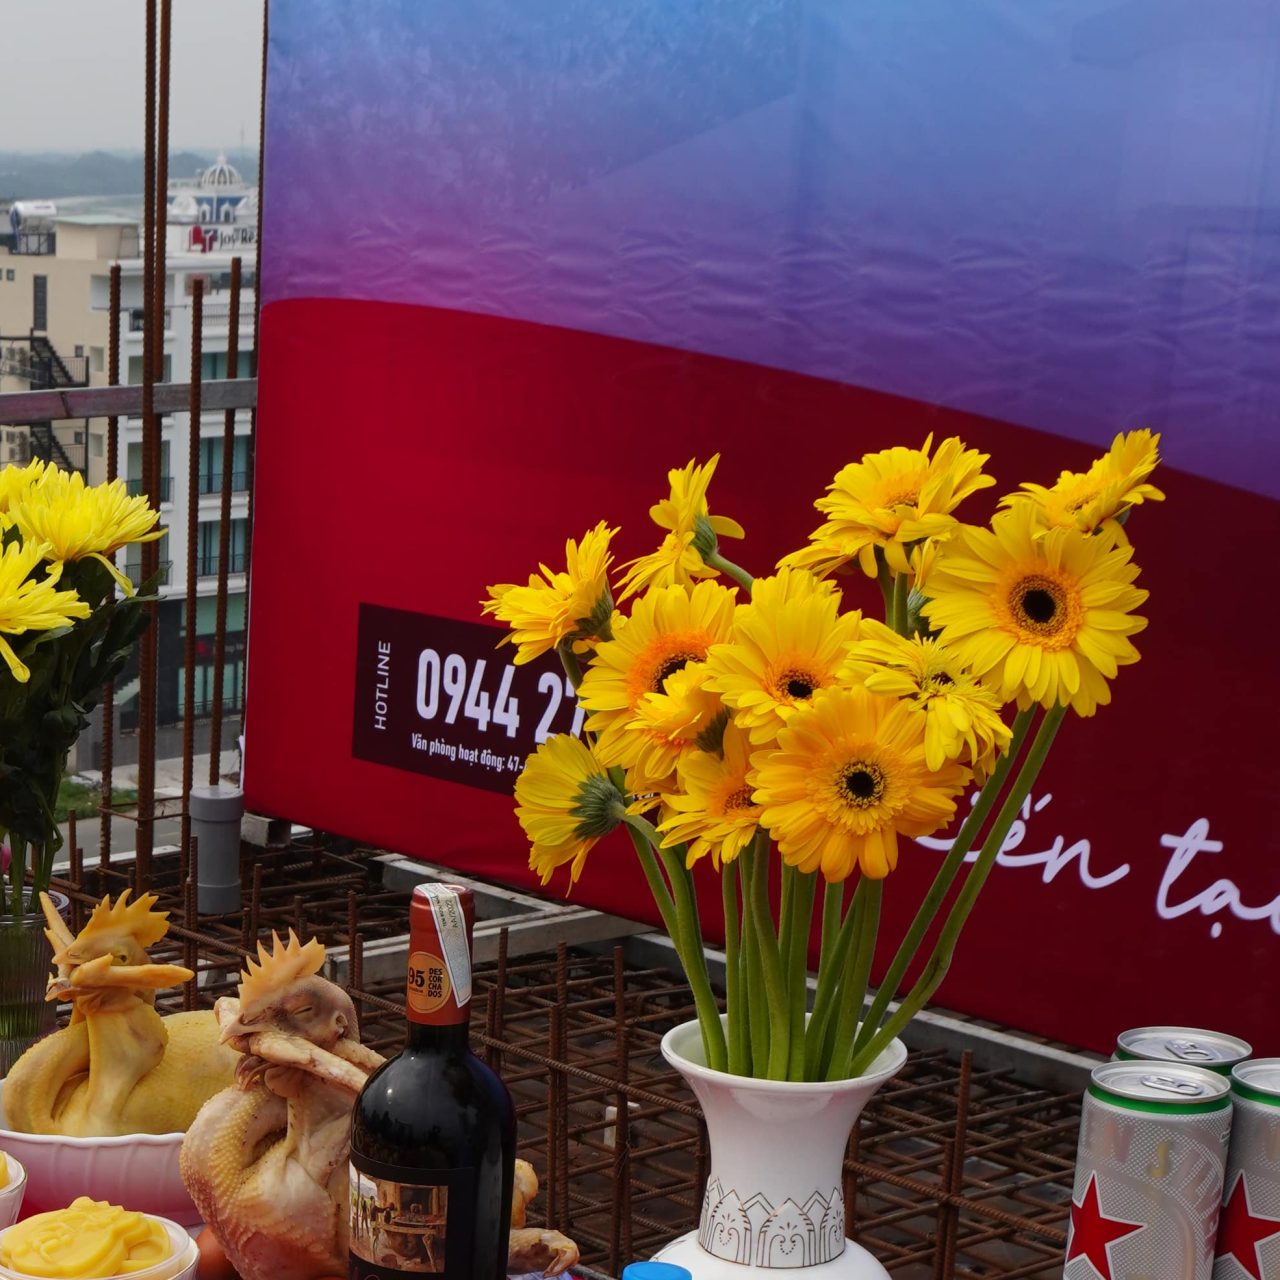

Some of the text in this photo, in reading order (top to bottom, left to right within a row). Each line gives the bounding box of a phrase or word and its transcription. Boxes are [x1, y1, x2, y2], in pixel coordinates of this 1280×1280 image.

[374, 640, 391, 730] HOTLINE
[416, 648, 520, 738] 0944
[429, 738, 456, 761] phòng
[458, 744, 478, 766] hoạt
[480, 749, 505, 772] động:
[507, 755, 526, 772] 47-
[1157, 817, 1280, 938] tạ
[408, 967, 425, 988] 95
